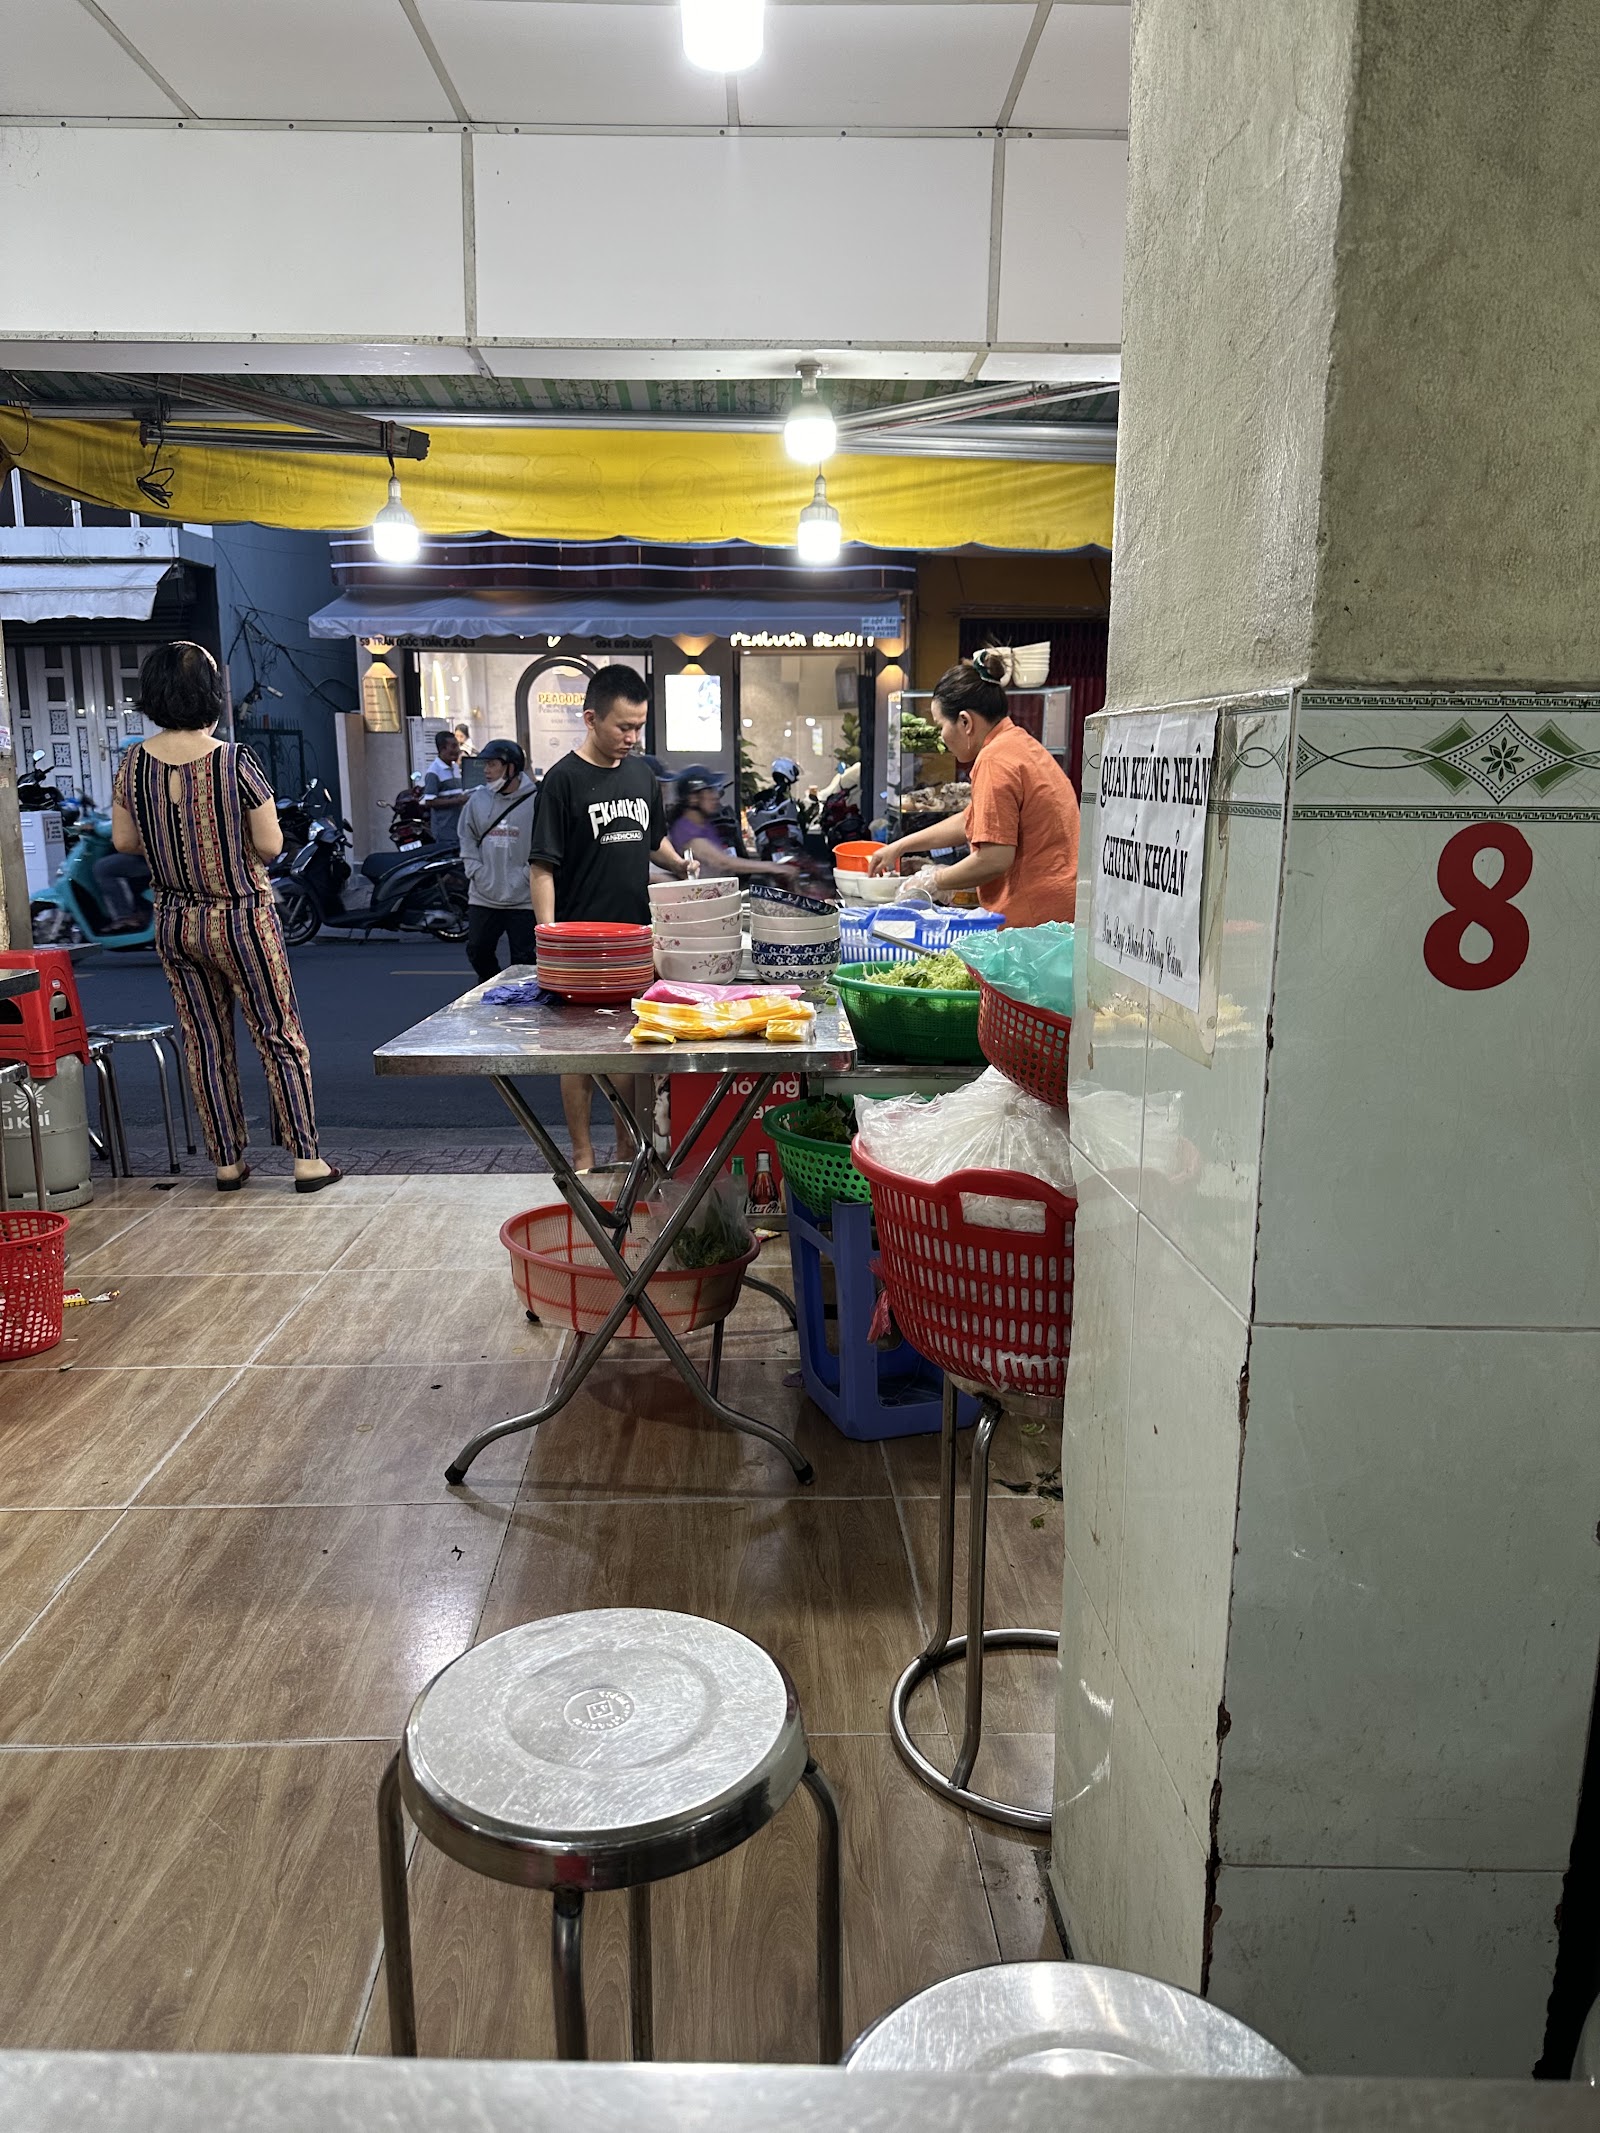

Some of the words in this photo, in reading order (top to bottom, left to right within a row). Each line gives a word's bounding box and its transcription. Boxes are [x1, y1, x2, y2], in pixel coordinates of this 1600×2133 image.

[1100, 743, 1129, 808] QUÁN
[1130, 744, 1170, 803] KHÔNG
[1172, 742, 1211, 818] NHẬN
[1103, 813, 1141, 885] CHUYỂN
[1143, 829, 1188, 898] KHOẢN
[1423, 821, 1533, 991] 8
